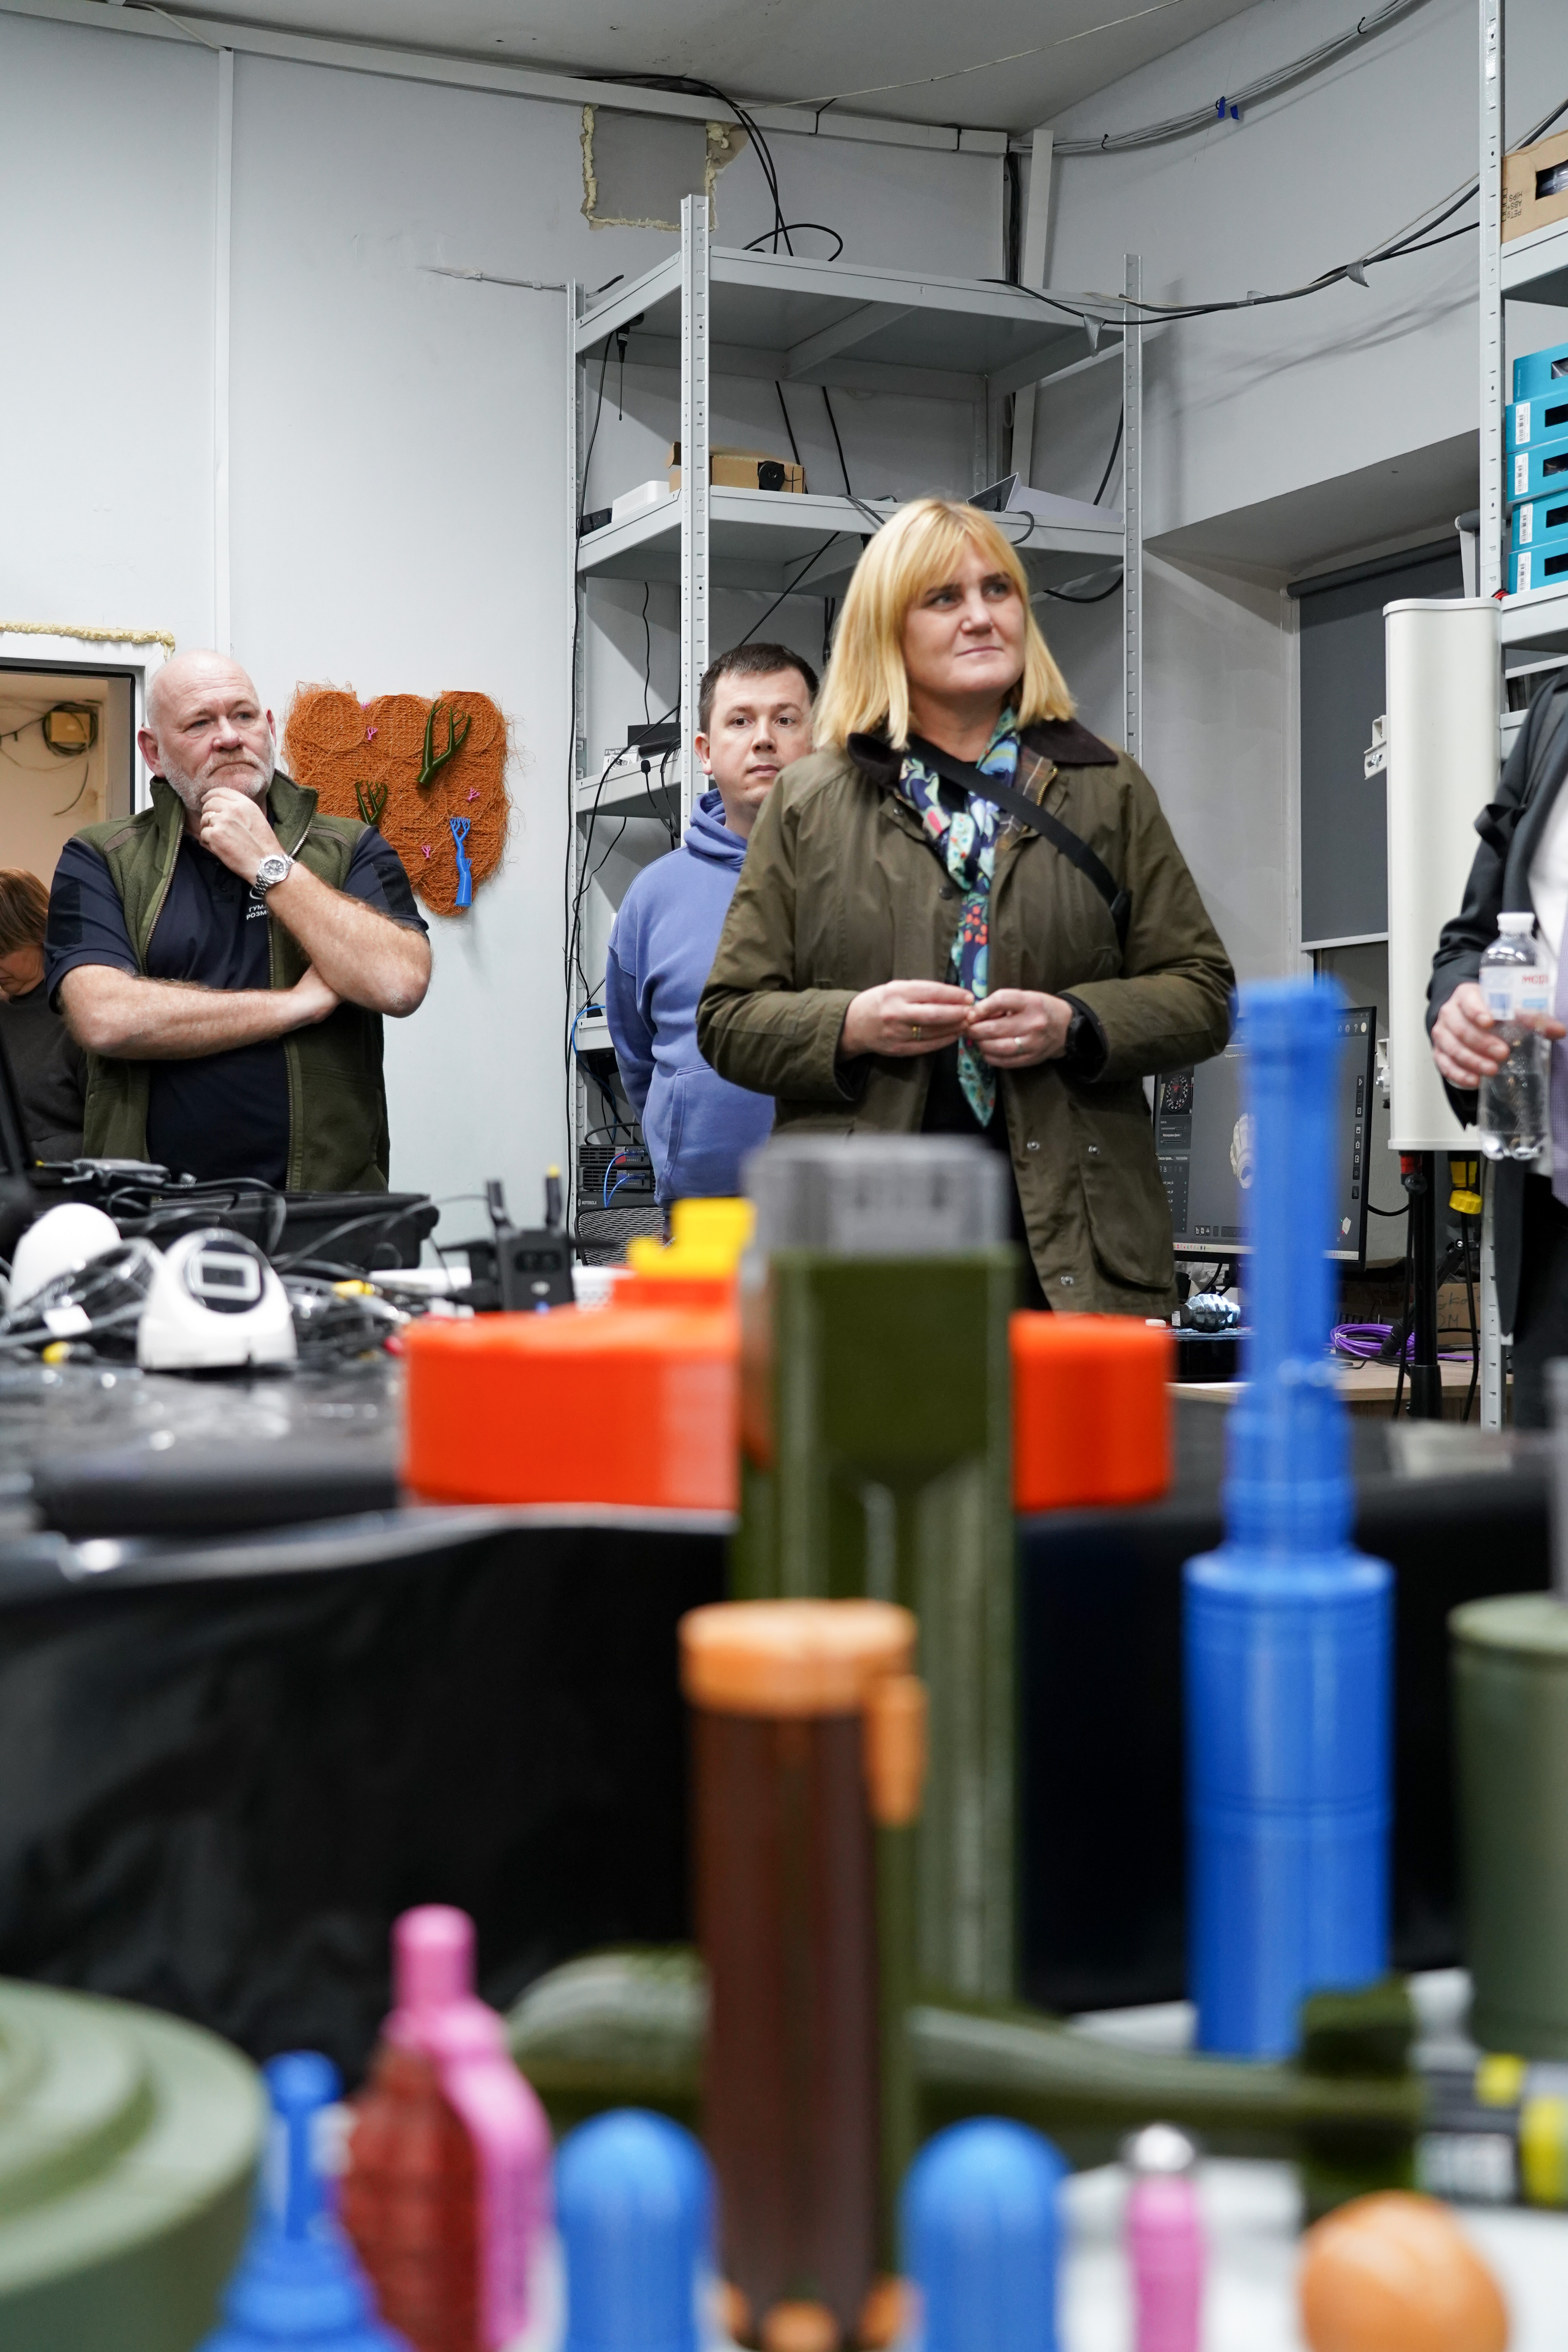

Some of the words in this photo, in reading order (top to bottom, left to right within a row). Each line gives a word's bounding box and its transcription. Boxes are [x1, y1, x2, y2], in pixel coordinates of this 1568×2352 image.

[1509, 191, 1523, 201] HIPS
[1507, 199, 1523, 210] ABS+
[249, 904, 266, 913] ГУМ
[247, 910, 269, 920] РОЗМ
